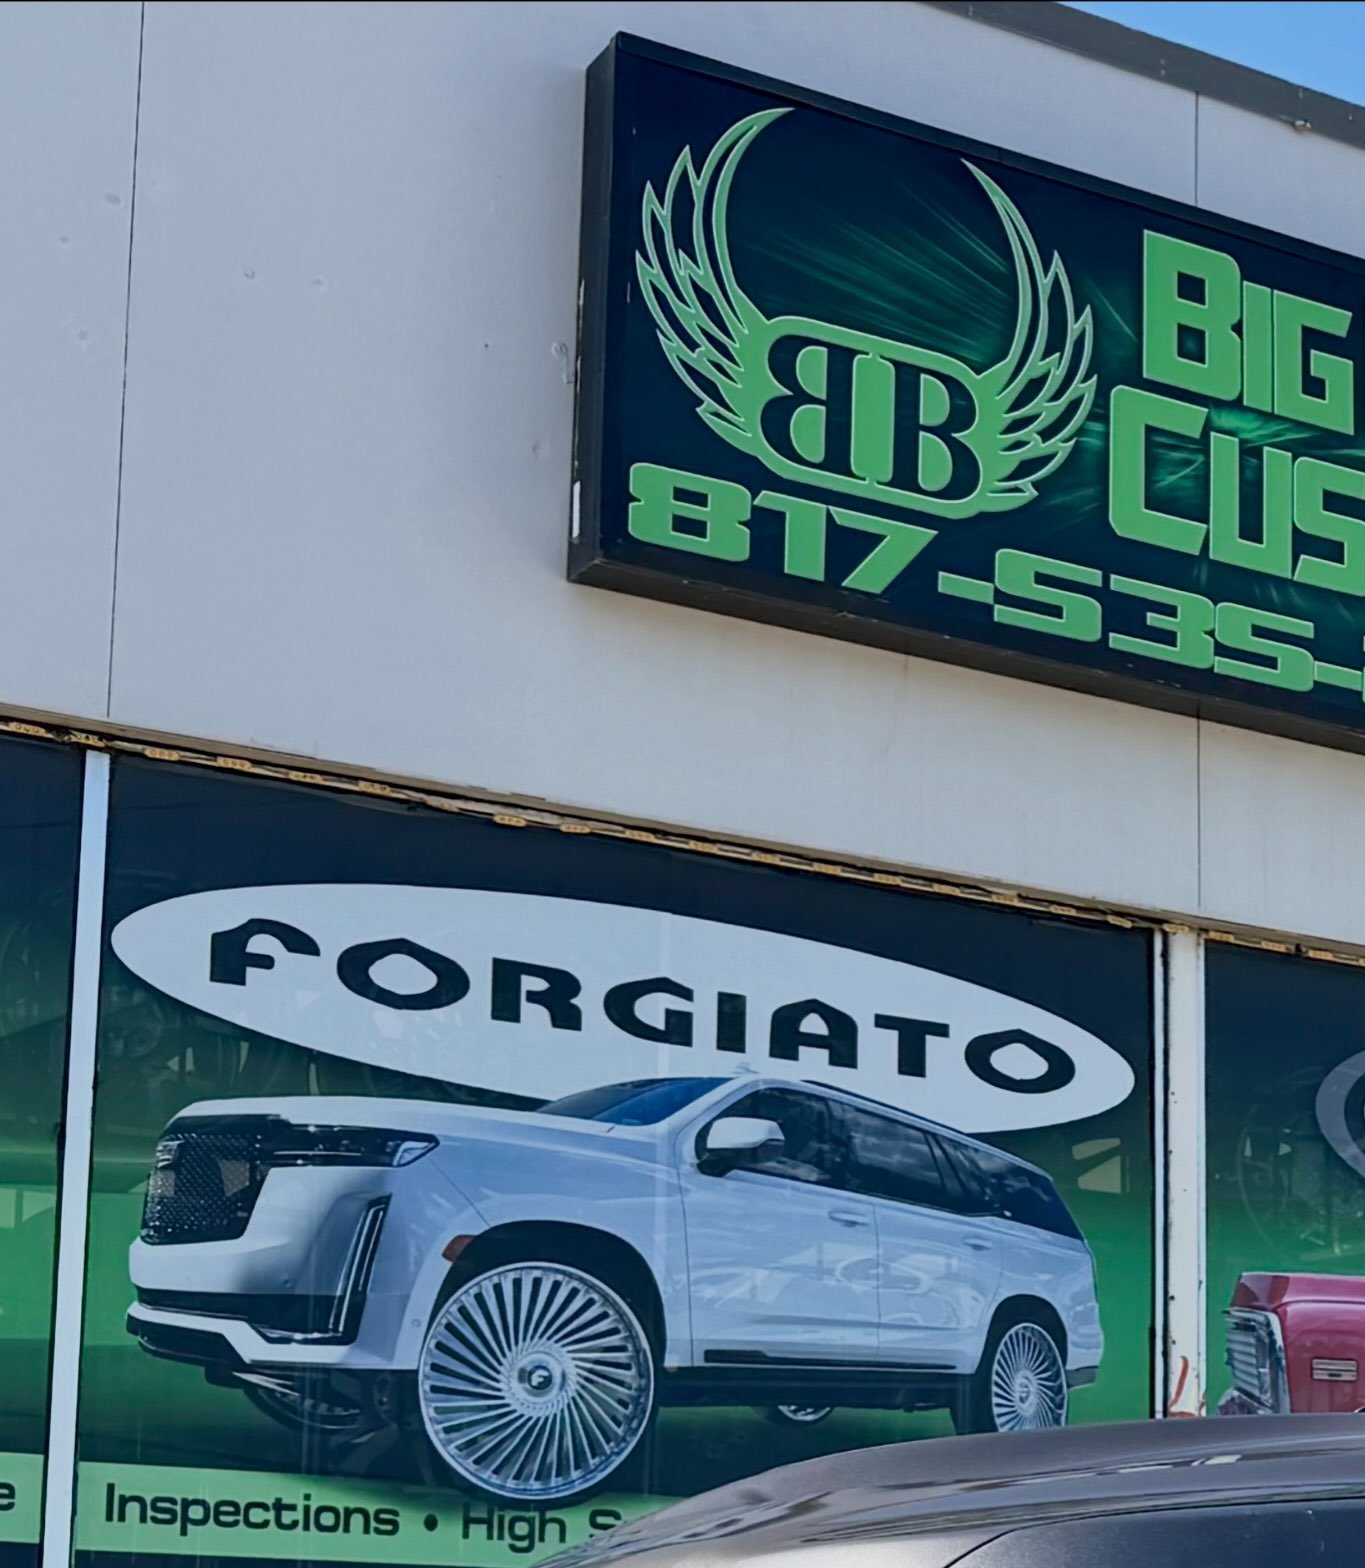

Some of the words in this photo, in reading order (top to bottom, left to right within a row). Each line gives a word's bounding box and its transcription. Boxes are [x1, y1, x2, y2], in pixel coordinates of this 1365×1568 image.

[1144, 229, 1354, 437] BIG
[209, 917, 1076, 1095] FORGIATO
[104, 1482, 400, 1537] Inspections
[462, 1500, 566, 1552] High
